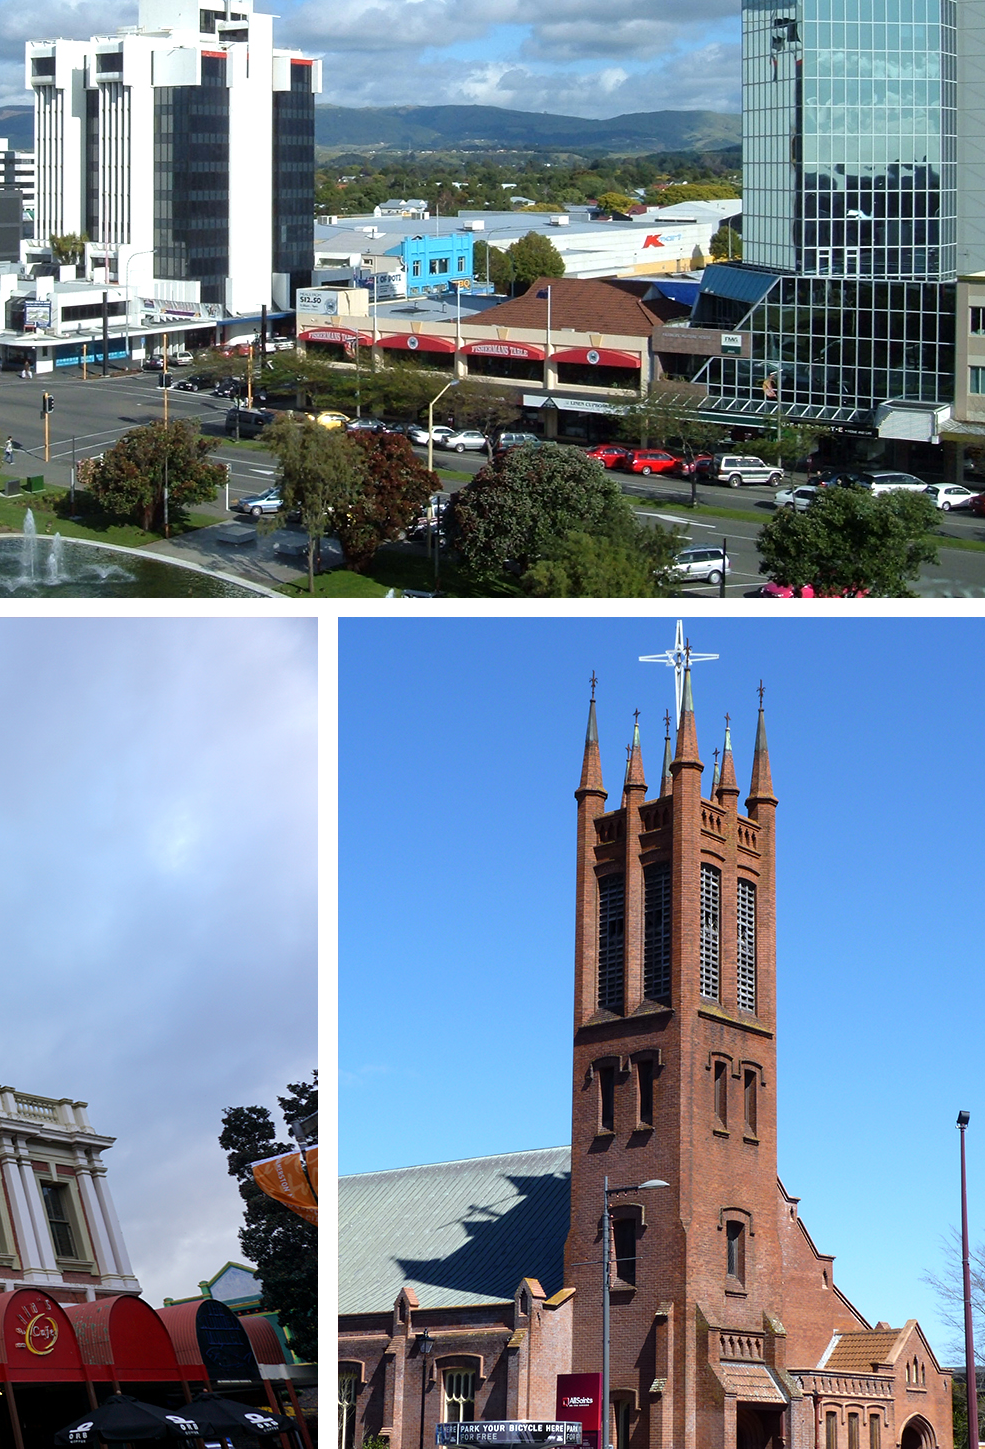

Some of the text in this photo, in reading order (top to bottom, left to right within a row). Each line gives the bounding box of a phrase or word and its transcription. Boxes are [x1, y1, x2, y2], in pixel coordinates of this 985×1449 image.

[471, 345, 529, 357] FISHERMANS TABLE
[180, 1423, 199, 1431] ORB
[256, 1420, 279, 1429] ORB
[483, 1424, 505, 1432] YOUR
[509, 1424, 542, 1432] BICYCLE
[546, 1424, 564, 1432] HERE
[68, 1432, 88, 1440] ORB
